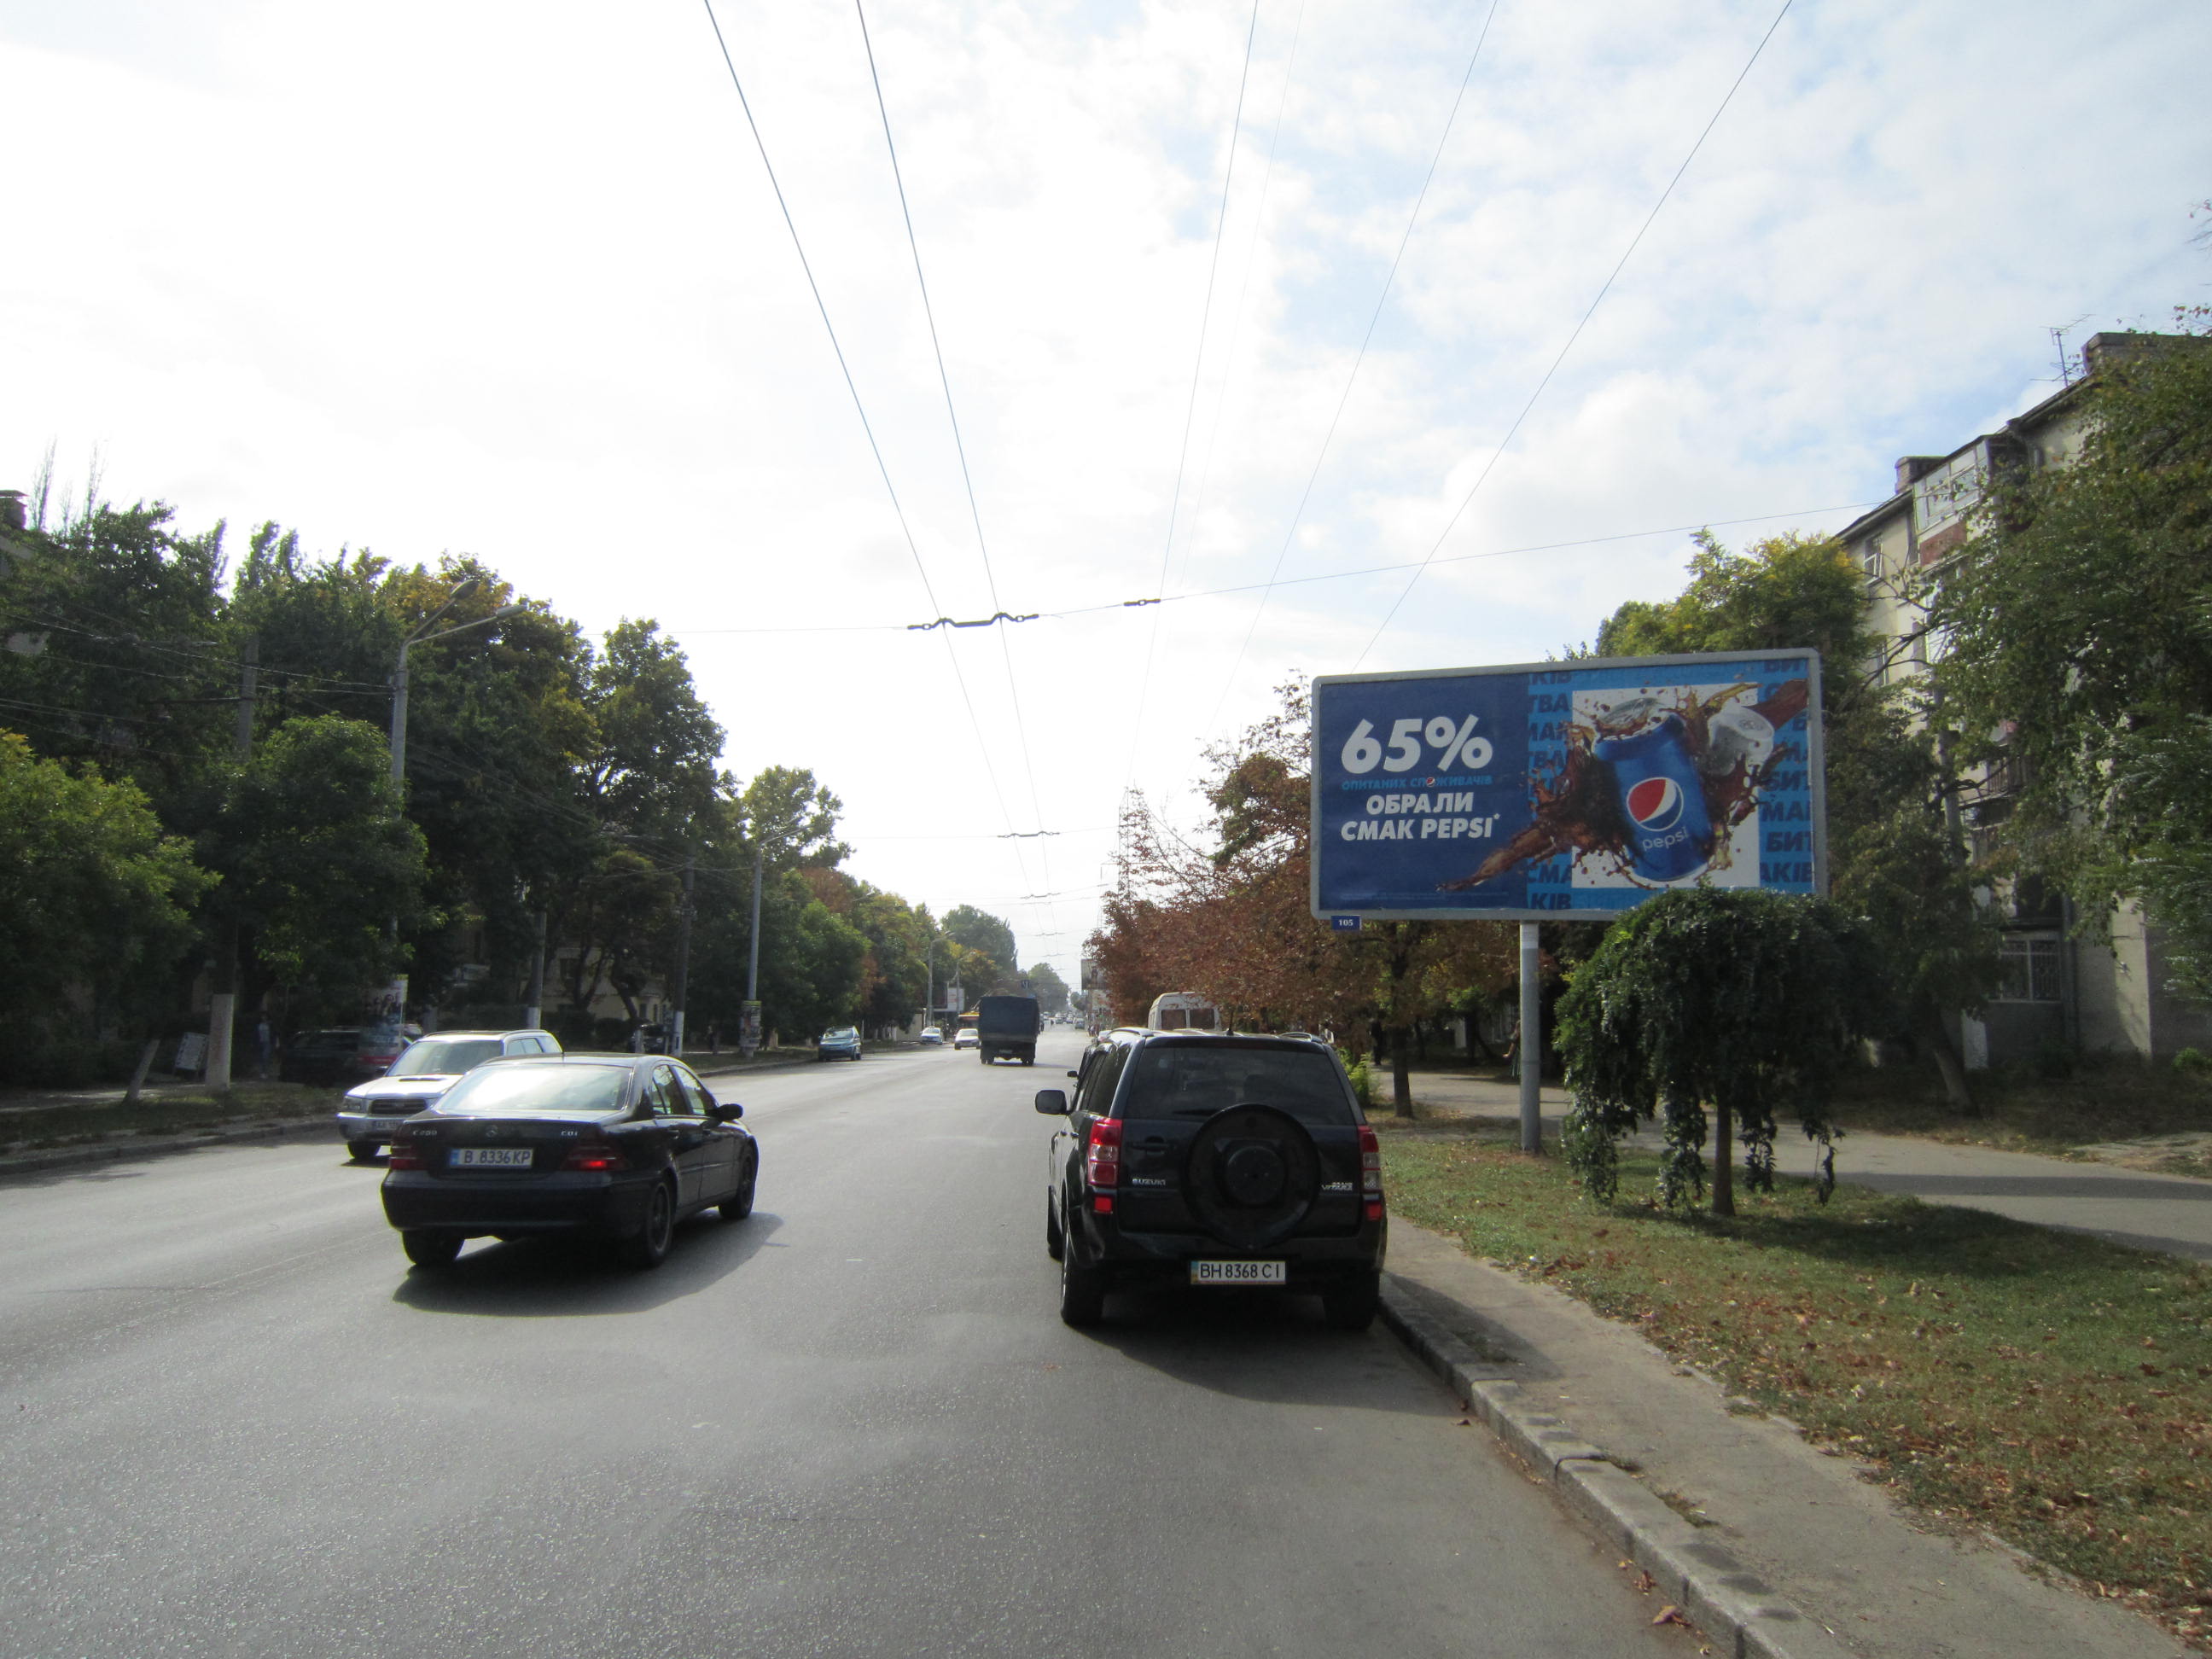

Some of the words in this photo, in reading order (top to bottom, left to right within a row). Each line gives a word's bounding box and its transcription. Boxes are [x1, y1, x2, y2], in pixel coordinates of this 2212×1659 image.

[1342, 714, 1493, 774] 65%
[1342, 779, 1407, 790] ОПИТАНИХ
[1366, 792, 1475, 815] ОБРАЛИ
[1341, 819, 1415, 841] СМАК
[1642, 826, 1688, 852] pepsi
[1338, 918, 1354, 928] 105
[480, 1150, 511, 1163] 8336
[1201, 1264, 1221, 1278] BH
[1225, 1264, 1258, 1278] 8368
